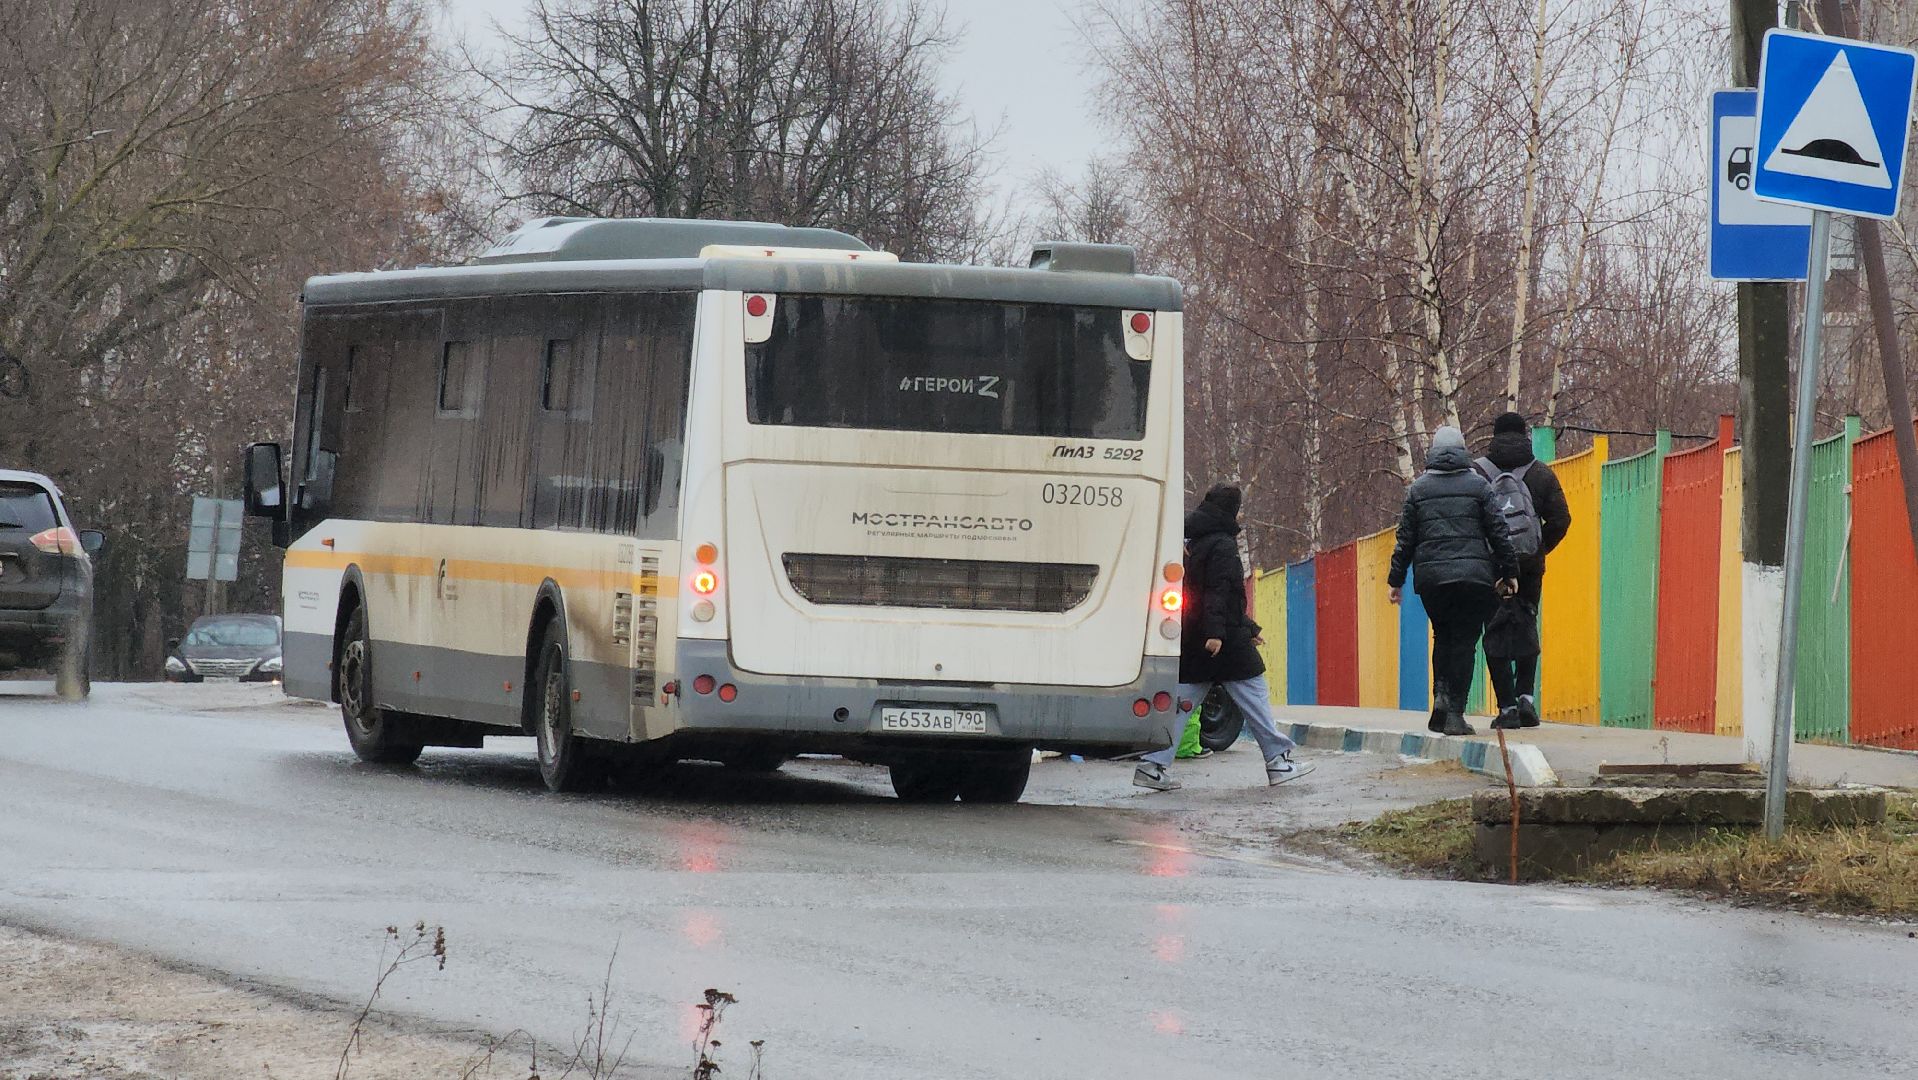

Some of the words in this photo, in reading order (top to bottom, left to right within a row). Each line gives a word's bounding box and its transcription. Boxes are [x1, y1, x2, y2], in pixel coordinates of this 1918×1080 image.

[1103, 447, 1144, 461] 5292
[1042, 482, 1123, 508] 032058
[852, 511, 1033, 532] МОСТРАНСАВТО
[956, 712, 981, 726] 790
